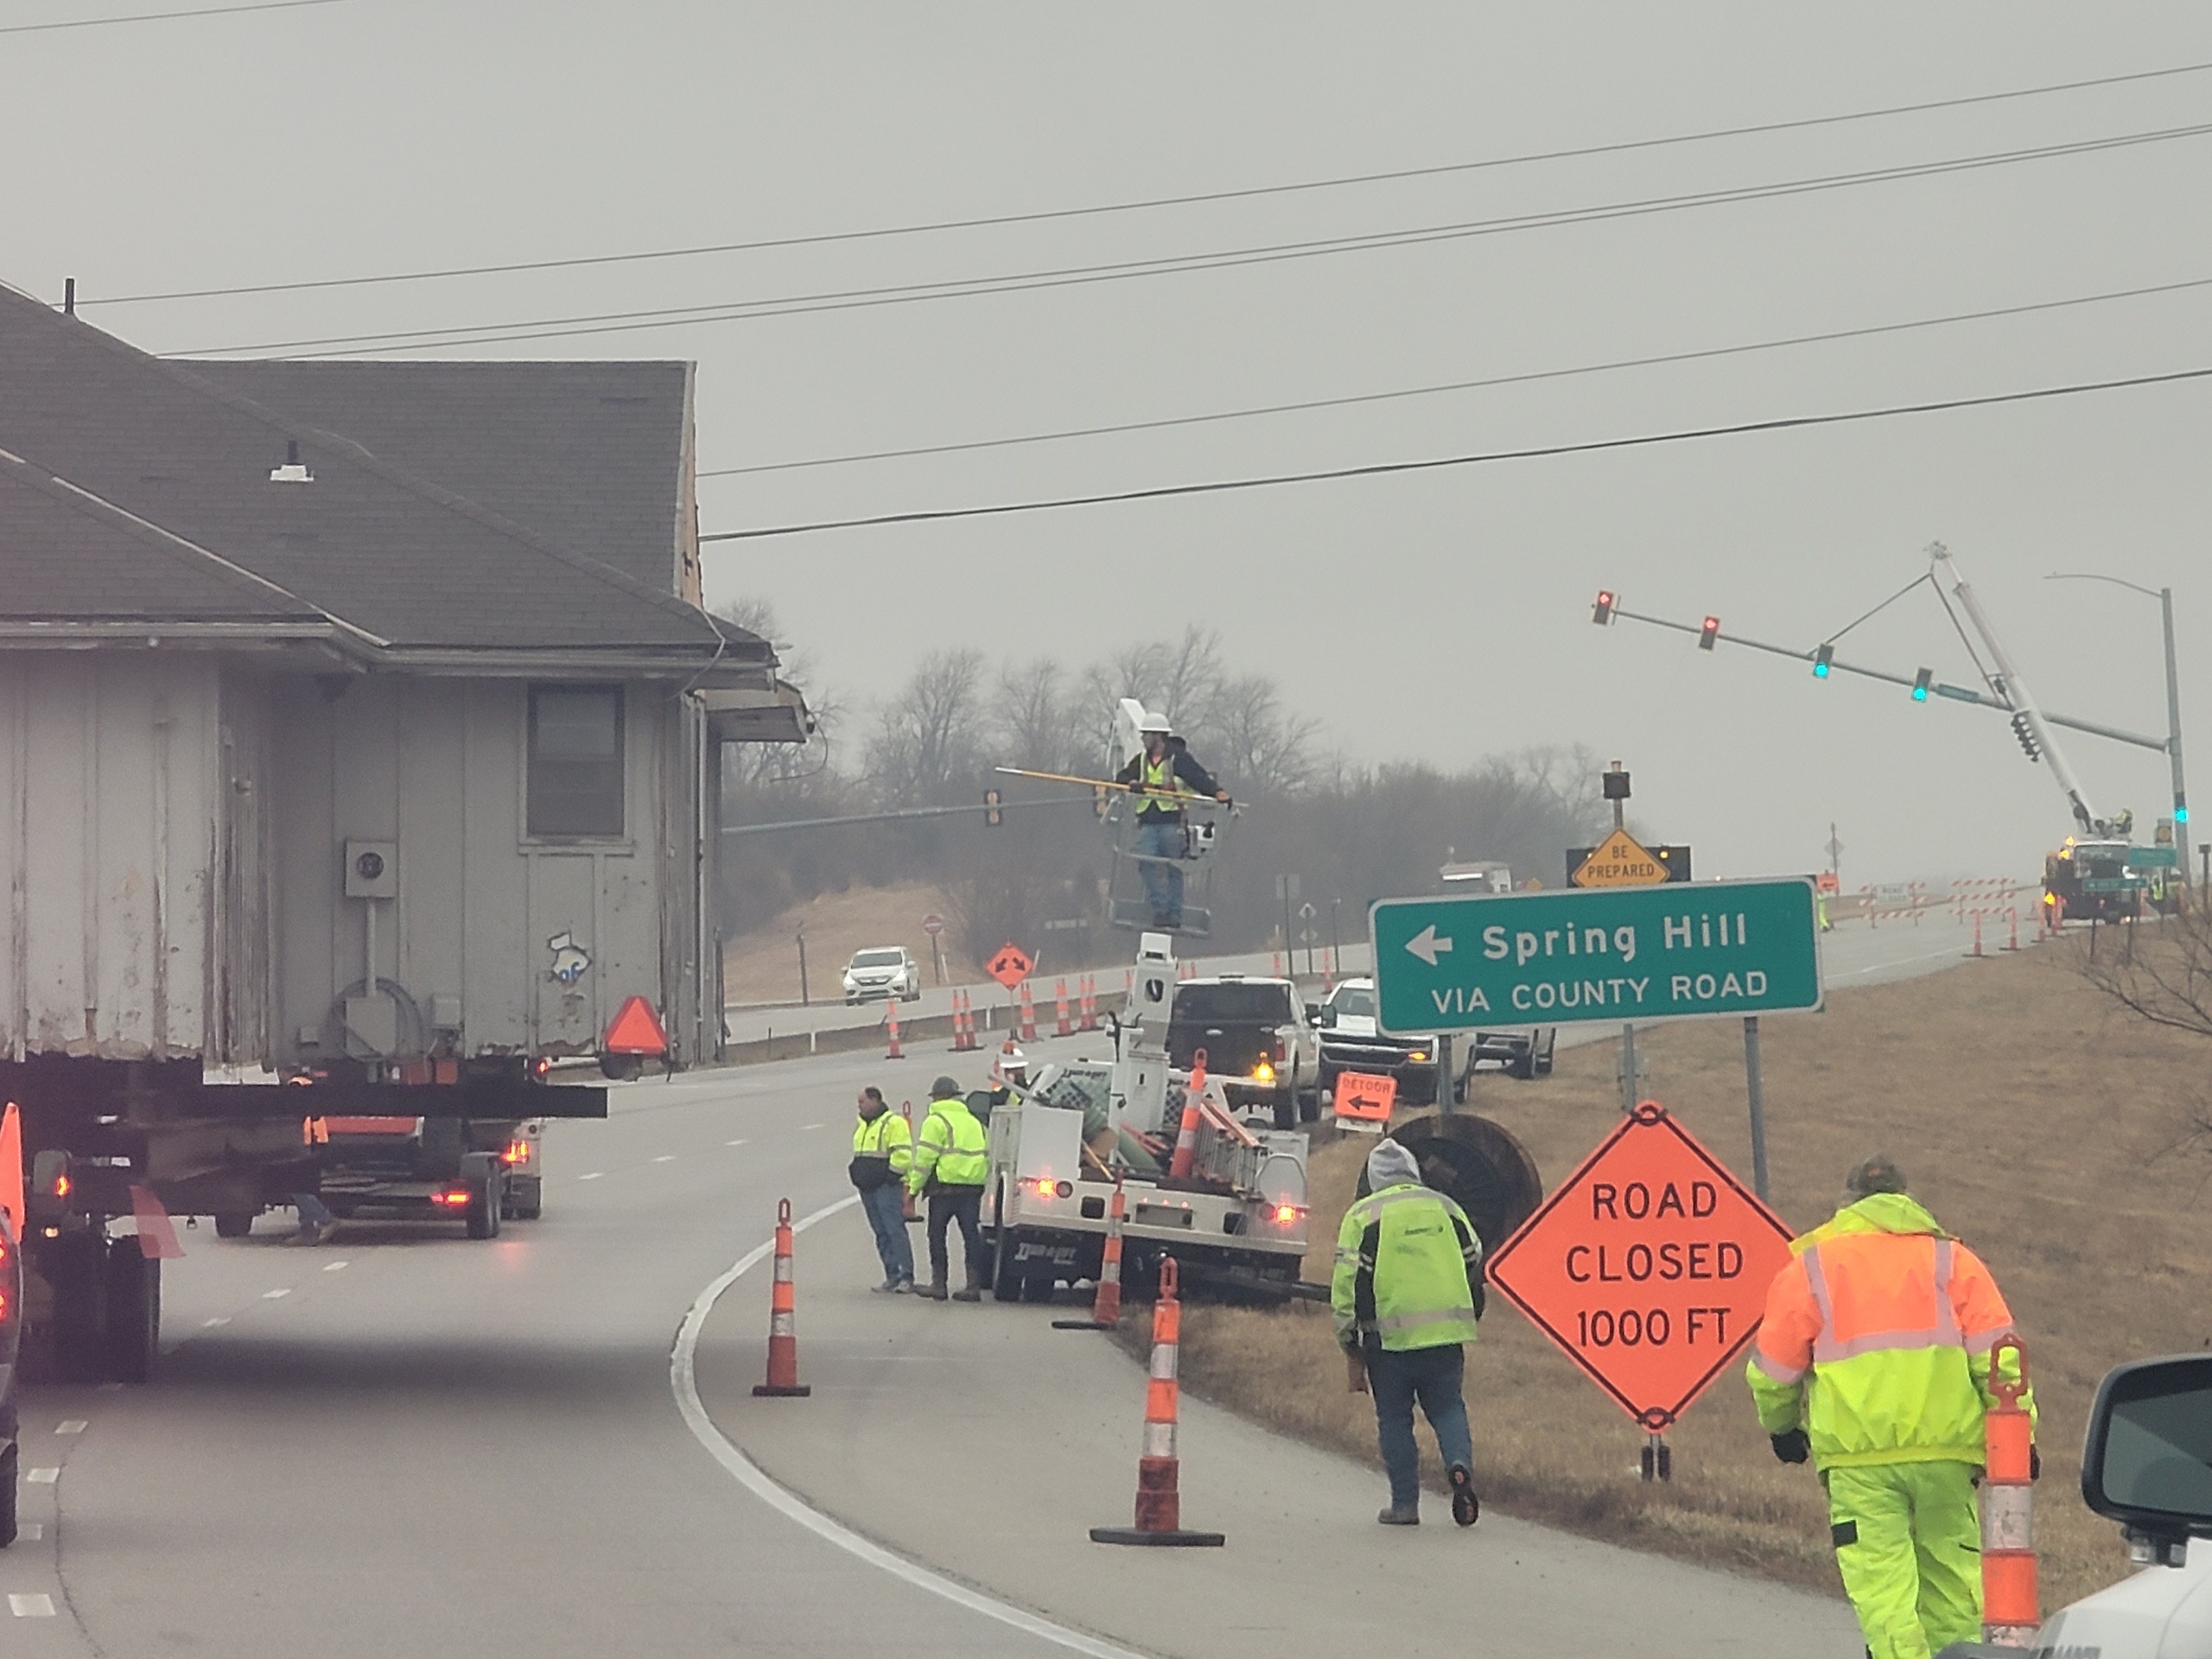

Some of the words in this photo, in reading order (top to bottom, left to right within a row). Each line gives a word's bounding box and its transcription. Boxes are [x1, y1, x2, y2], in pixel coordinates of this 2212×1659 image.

[1587, 863, 1655, 878] PREPARED
[1612, 846, 1628, 858] BE
[1483, 923, 1636, 965] Spring
[1664, 914, 1745, 949] Hill
[1432, 988, 1490, 1014] VIA
[1512, 978, 1649, 1009] COUNTY
[1673, 971, 1767, 1000] ROAD
[1593, 1181, 1717, 1219] ROAD
[1567, 1243, 1744, 1281] CLOSED
[1578, 1308, 1670, 1347] 1000
[1688, 1307, 1731, 1344] FT
